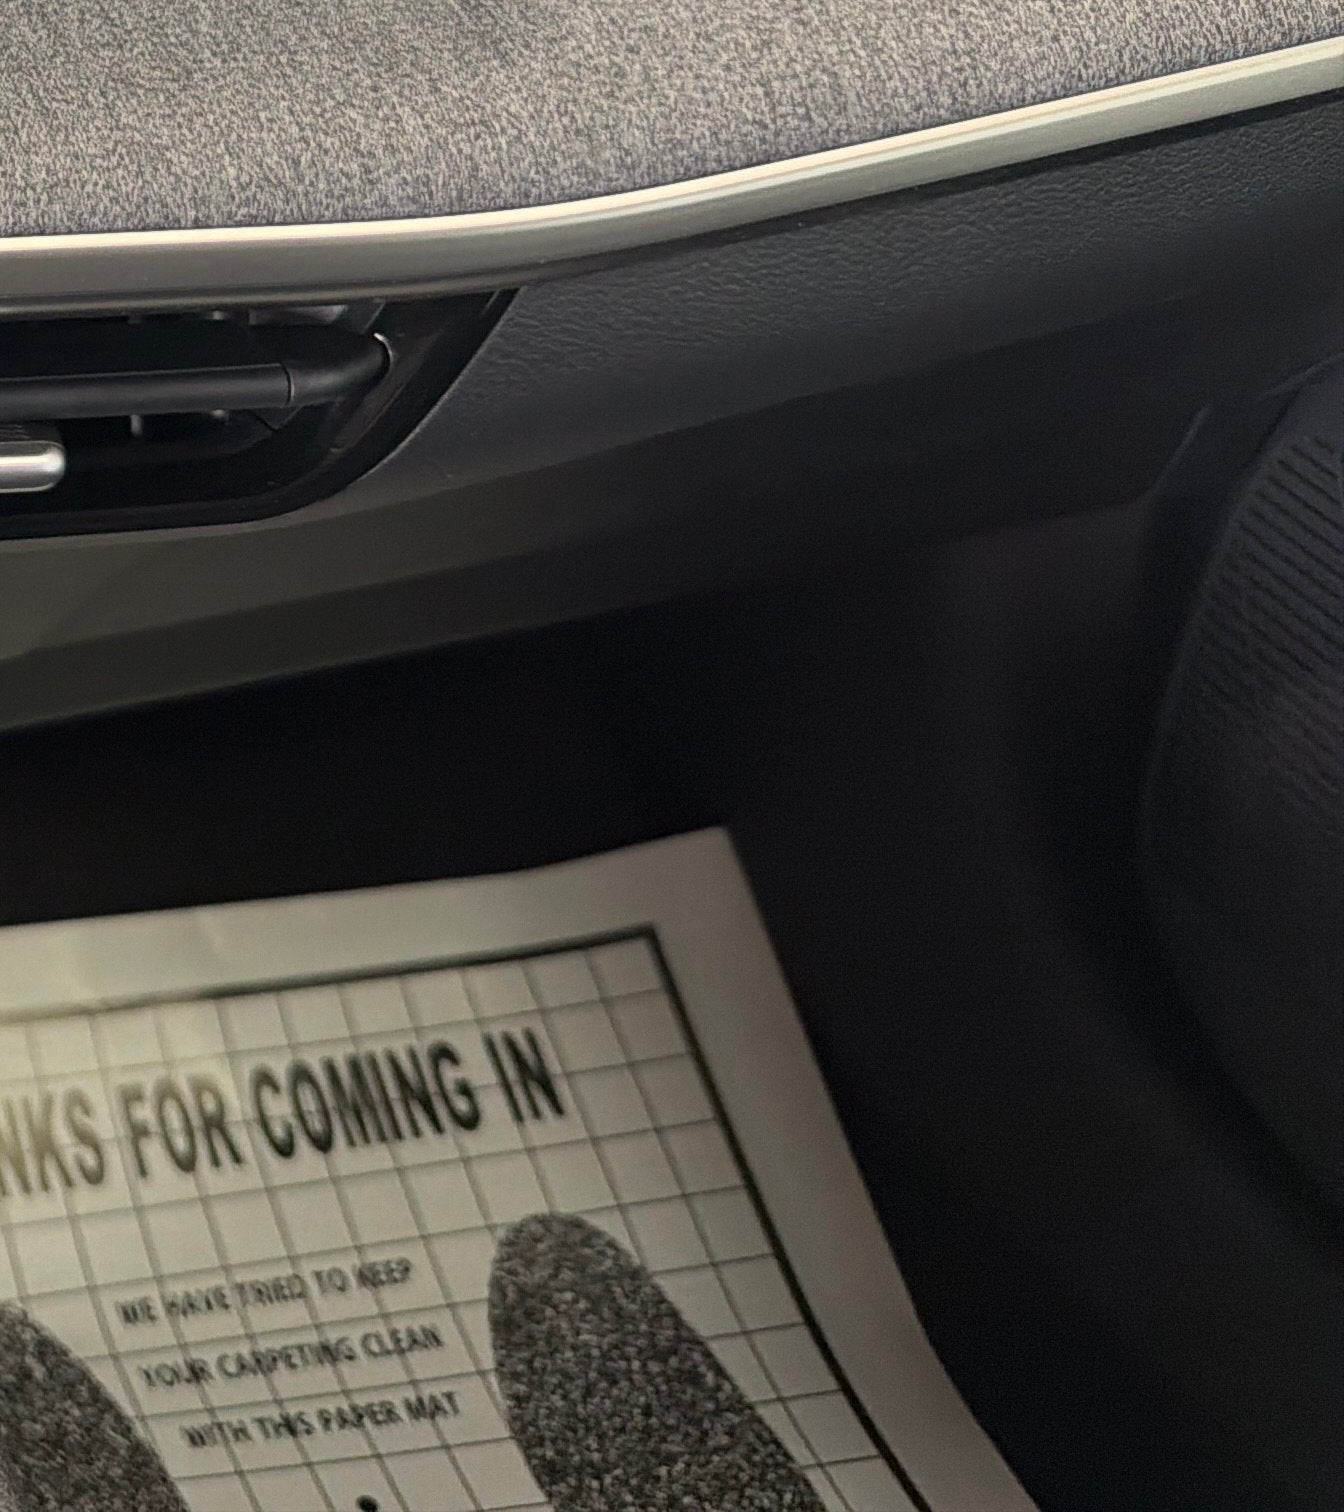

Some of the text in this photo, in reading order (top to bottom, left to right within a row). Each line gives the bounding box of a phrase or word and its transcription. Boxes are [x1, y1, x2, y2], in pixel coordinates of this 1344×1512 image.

[116, 1076, 243, 1179] FOR
[246, 1040, 483, 1160] COMING
[482, 1026, 566, 1126] IN
[116, 1256, 412, 1326] WE HAVE TRIED TO KEEP
[138, 1323, 446, 1390] YOUR CARPETING CLEAN
[180, 1390, 460, 1449] WITH THIS PAPER MAT
